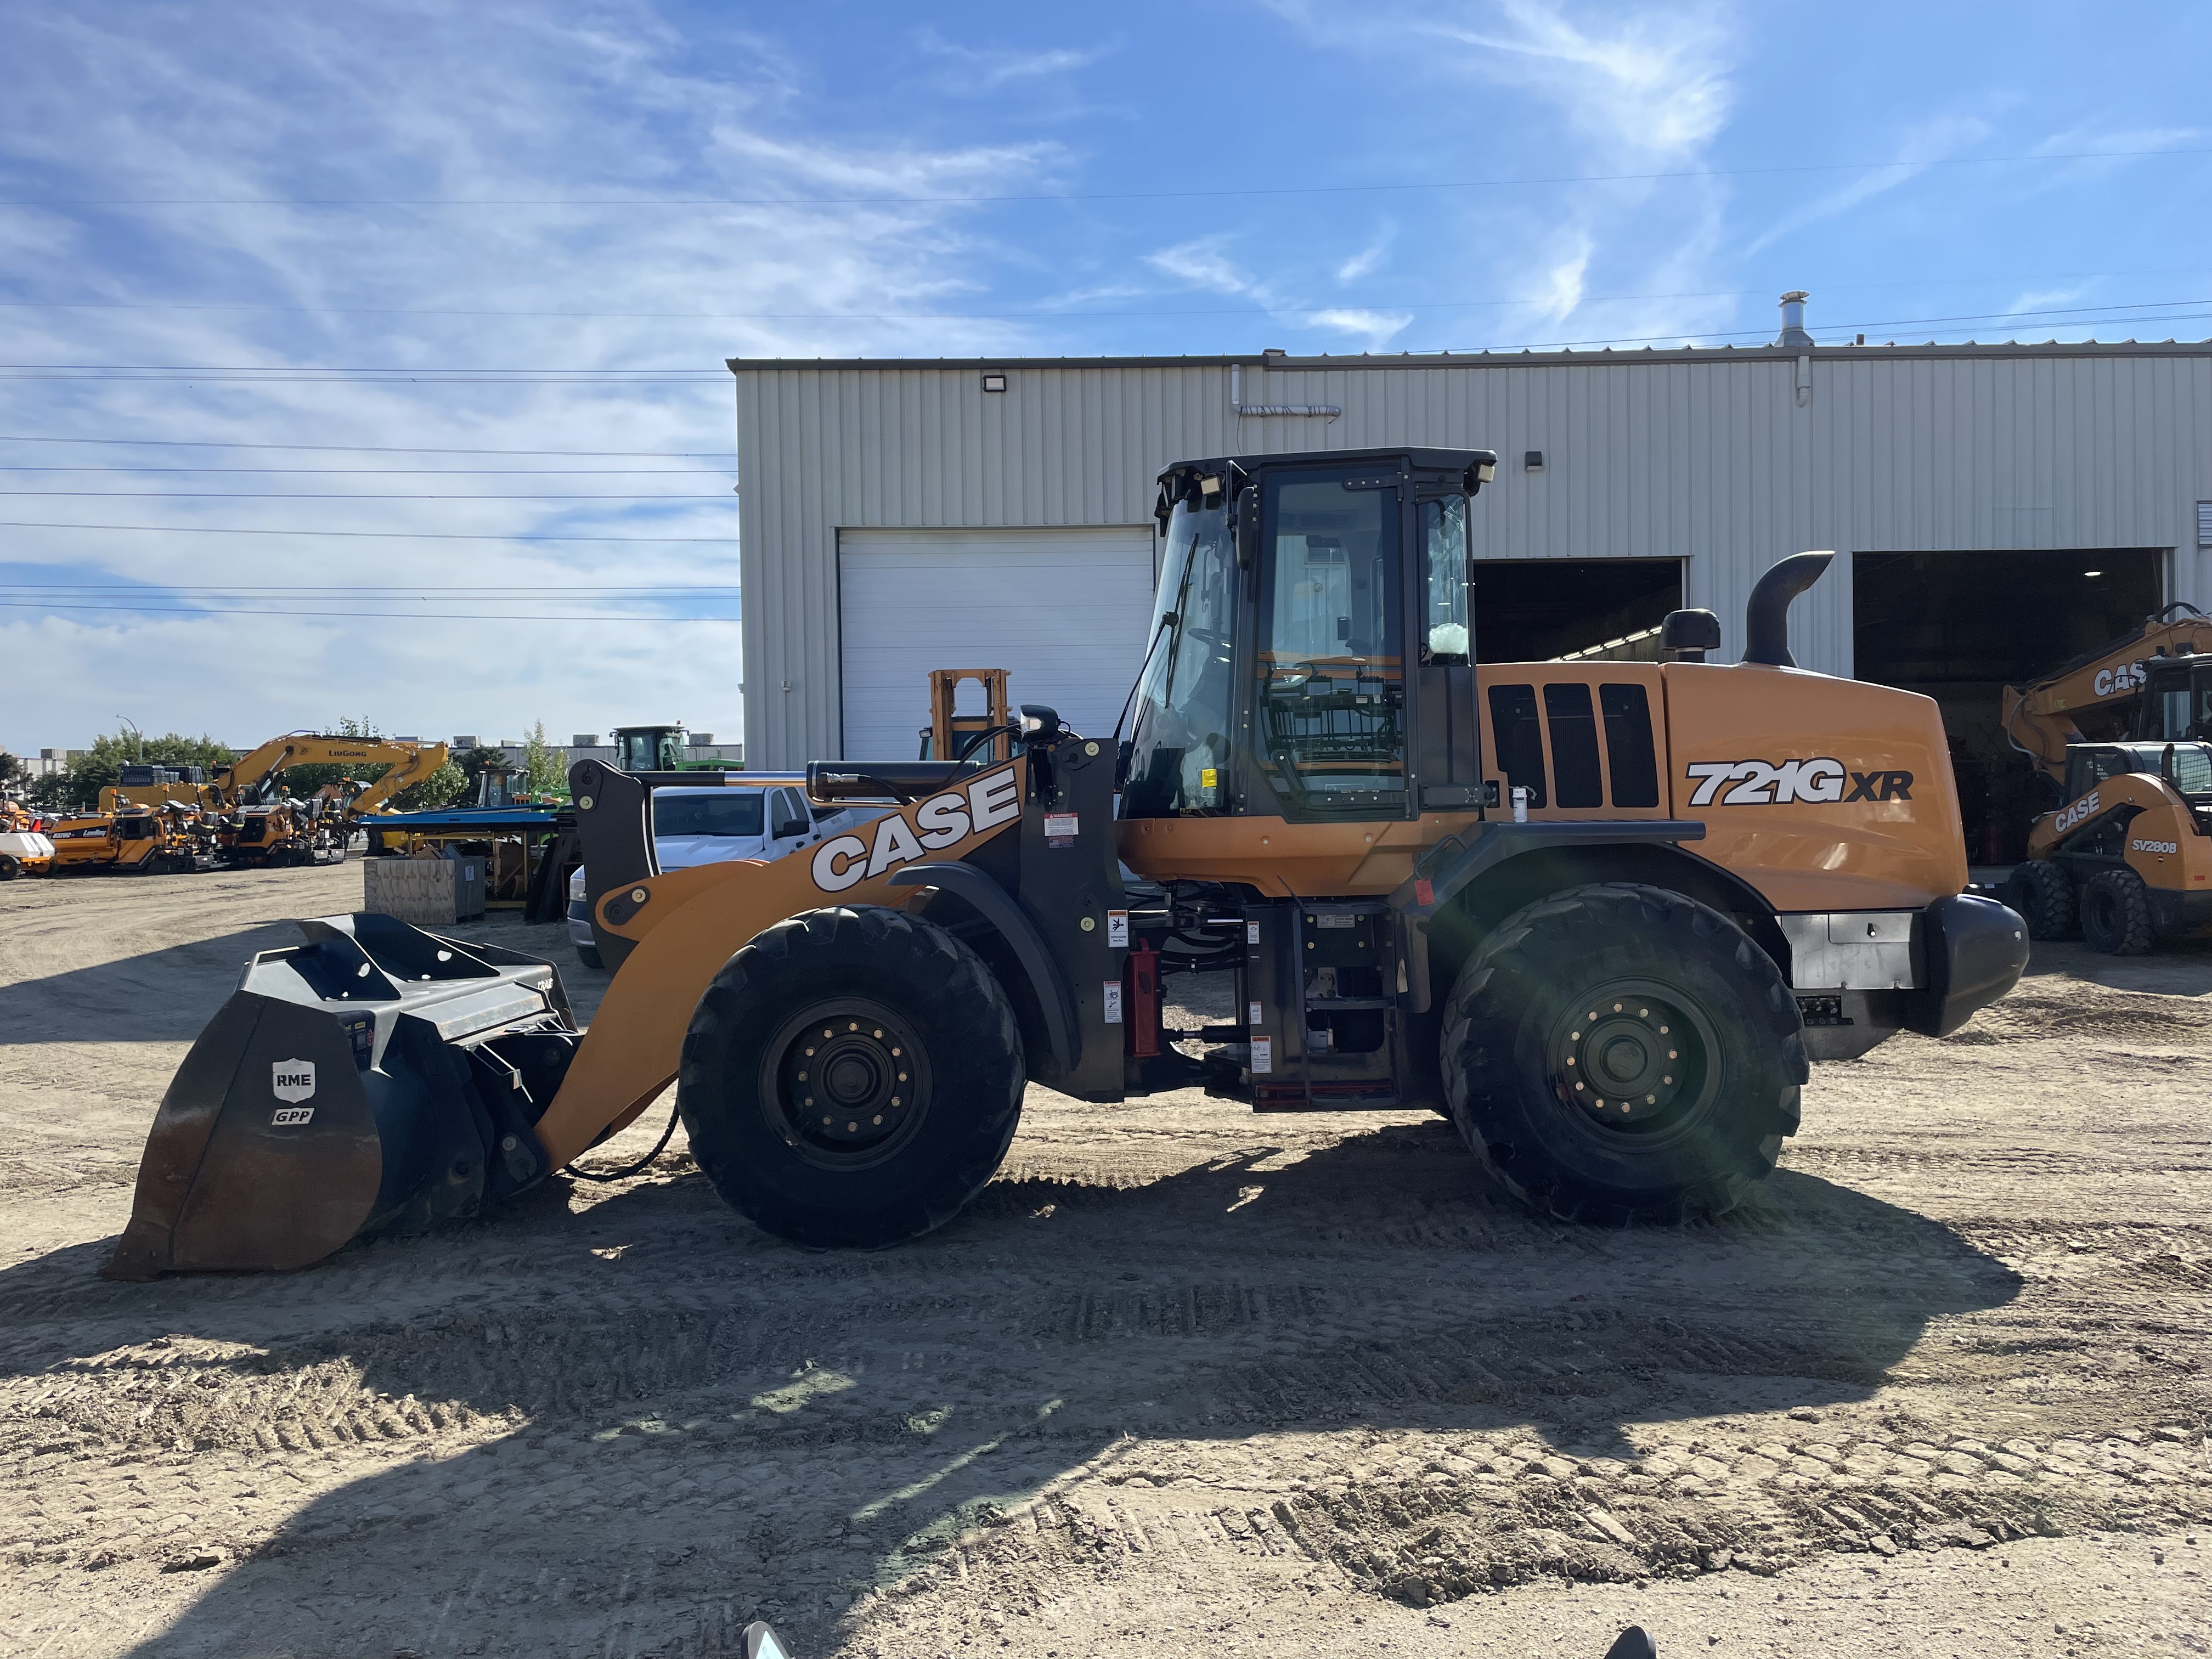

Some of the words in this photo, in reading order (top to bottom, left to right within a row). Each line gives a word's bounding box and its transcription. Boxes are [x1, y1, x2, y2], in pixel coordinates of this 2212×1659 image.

[2094, 655, 2165, 697] CAS
[1685, 757, 1846, 807] 721G
[1843, 770, 1914, 803] XR
[811, 765, 1020, 893] CASE
[2055, 792, 2100, 833] CASE
[2132, 839, 2177, 854] SV280B
[277, 1074, 311, 1086] RME
[276, 1111, 310, 1122] GPP
